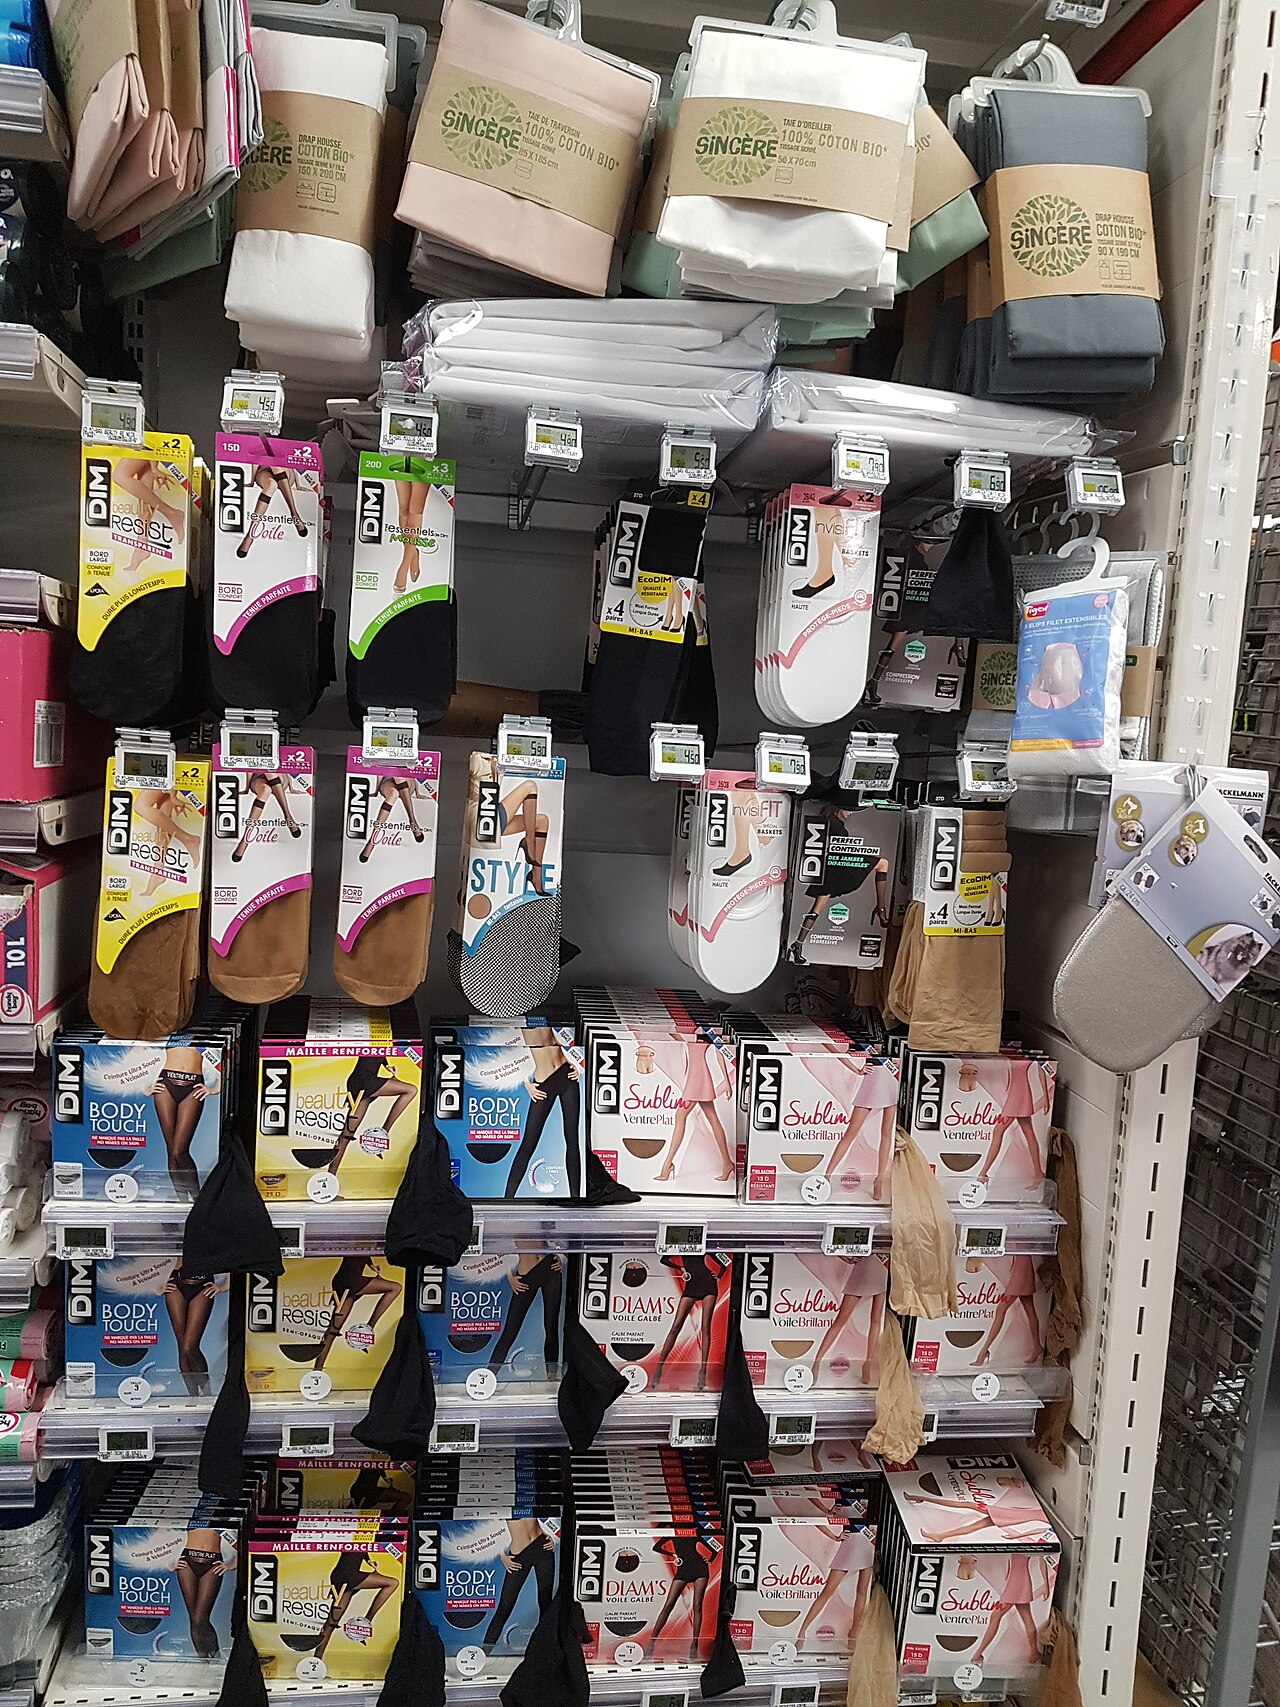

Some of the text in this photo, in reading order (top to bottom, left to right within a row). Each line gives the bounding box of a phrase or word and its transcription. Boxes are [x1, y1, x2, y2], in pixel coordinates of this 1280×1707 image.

[528, 110, 581, 139] TAIE TRAVERSIN
[783, 118, 832, 132] TAIE D'OREILLER
[317, 137, 341, 149] HOUSSE
[525, 121, 595, 161] 100% COTON
[781, 129, 857, 152] 100% COTON
[298, 144, 331, 160] COTON
[320, 168, 333, 179] 200
[1096, 223, 1127, 238] COTON
[1097, 246, 1108, 256] 90
[162, 438, 181, 449] x2
[222, 443, 312, 457] 15D x2
[365, 460, 449, 473] 20D x3
[90, 465, 109, 519] DIM
[223, 472, 242, 525] DIM
[362, 487, 381, 537] DIM
[112, 534, 166, 556] TRANSPARENT
[389, 533, 437, 548] Mousse
[790, 514, 809, 559] DIM
[613, 520, 639, 579] DIM
[130, 578, 165, 597] LONGTEMPS
[218, 585, 242, 594] BORD
[356, 575, 379, 583] BORD
[880, 556, 905, 612] DIM
[243, 585, 292, 619] TENUE PARFAITE
[375, 593, 423, 625] TENUE PARFAITE
[606, 600, 625, 616] x4
[628, 627, 653, 637] MI-BAS
[1029, 614, 1108, 629] SLIPS FILET EXTENSIBLES
[287, 751, 305, 762] x2
[182, 767, 199, 778] x2
[218, 782, 237, 832] DIM
[350, 783, 367, 833] DIM
[479, 787, 498, 836] DIM
[110, 798, 130, 848] DIM
[710, 799, 726, 842] DIM
[803, 823, 826, 878] DIM
[830, 845, 879, 855] CONTENTION
[831, 836, 862, 845] PERFECT
[935, 826, 956, 883] DIM
[130, 861, 181, 881] TRANSPARENT
[470, 858, 556, 896] STYLE
[960, 874, 992, 884] EcoDIM
[342, 888, 363, 897] BORD
[144, 902, 179, 923] LONGTEMPS
[237, 885, 285, 922] TENUE PARFAITE
[361, 887, 406, 920] TENUE PARFAITE
[929, 903, 948, 919] x4
[810, 933, 845, 941] COMPRESSION
[6, 937, 26, 969] 10L
[286, 1046, 398, 1056] MAILLE RENFORCÉE
[103, 1057, 161, 1080] Ceinture Souple
[599, 1050, 619, 1107] DIM
[58, 1054, 80, 1115] DIM
[440, 1054, 462, 1111] DIM
[265, 1068, 288, 1128] DIM
[295, 1086, 365, 1116] beauty
[623, 1083, 692, 1111] Sublim
[758, 1066, 779, 1123] DIM
[919, 1068, 942, 1123] DIM
[89, 1102, 146, 1120] BODY
[468, 1097, 520, 1114] BODY
[783, 1100, 851, 1127] Sublim
[944, 1100, 1007, 1127] Sublim
[89, 1118, 147, 1133] TOUCH
[468, 1113, 520, 1127] TOUCH
[623, 1113, 675, 1126] VentrePlat
[780, 1129, 845, 1142] VoileBrillant
[943, 1129, 992, 1141] VentrePlat
[71, 1259, 93, 1318] DIM
[587, 1257, 609, 1312] DIM
[749, 1256, 770, 1311] DIM
[957, 1282, 1007, 1306] Sublim
[252, 1273, 273, 1325] DIM
[282, 1286, 350, 1313] beauty
[450, 1291, 502, 1307] BODY
[612, 1295, 675, 1315] DIAM'S
[774, 1288, 841, 1314] Sublim
[102, 1303, 158, 1320] BODY
[450, 1306, 502, 1319] TOUCH
[102, 1318, 158, 1332] TOUCH
[772, 1317, 834, 1328] VoileBrillant
[337, 1460, 394, 1469] RENFORCÉE
[956, 1457, 1008, 1467] DIM
[272, 1542, 379, 1552] MAILLE RENFORCÉE
[418, 1529, 438, 1583] DIM
[90, 1534, 110, 1588] DIM
[736, 1534, 758, 1584] DIM
[445, 1570, 496, 1586] BODY
[580, 1546, 602, 1596] DIM
[761, 1563, 828, 1588] Sublim
[119, 1576, 170, 1592] BODY
[254, 1561, 275, 1616] DIM
[283, 1579, 347, 1606] beauty
[445, 1584, 496, 1597] TOUCH
[605, 1580, 668, 1597] DIAM'S
[916, 1558, 941, 1608] DIM
[119, 1590, 171, 1604] TOUCH
[759, 1589, 821, 1600] VoileBrillant
[940, 1587, 1006, 1612] Sublim
[938, 1614, 989, 1625] VentrePlat
